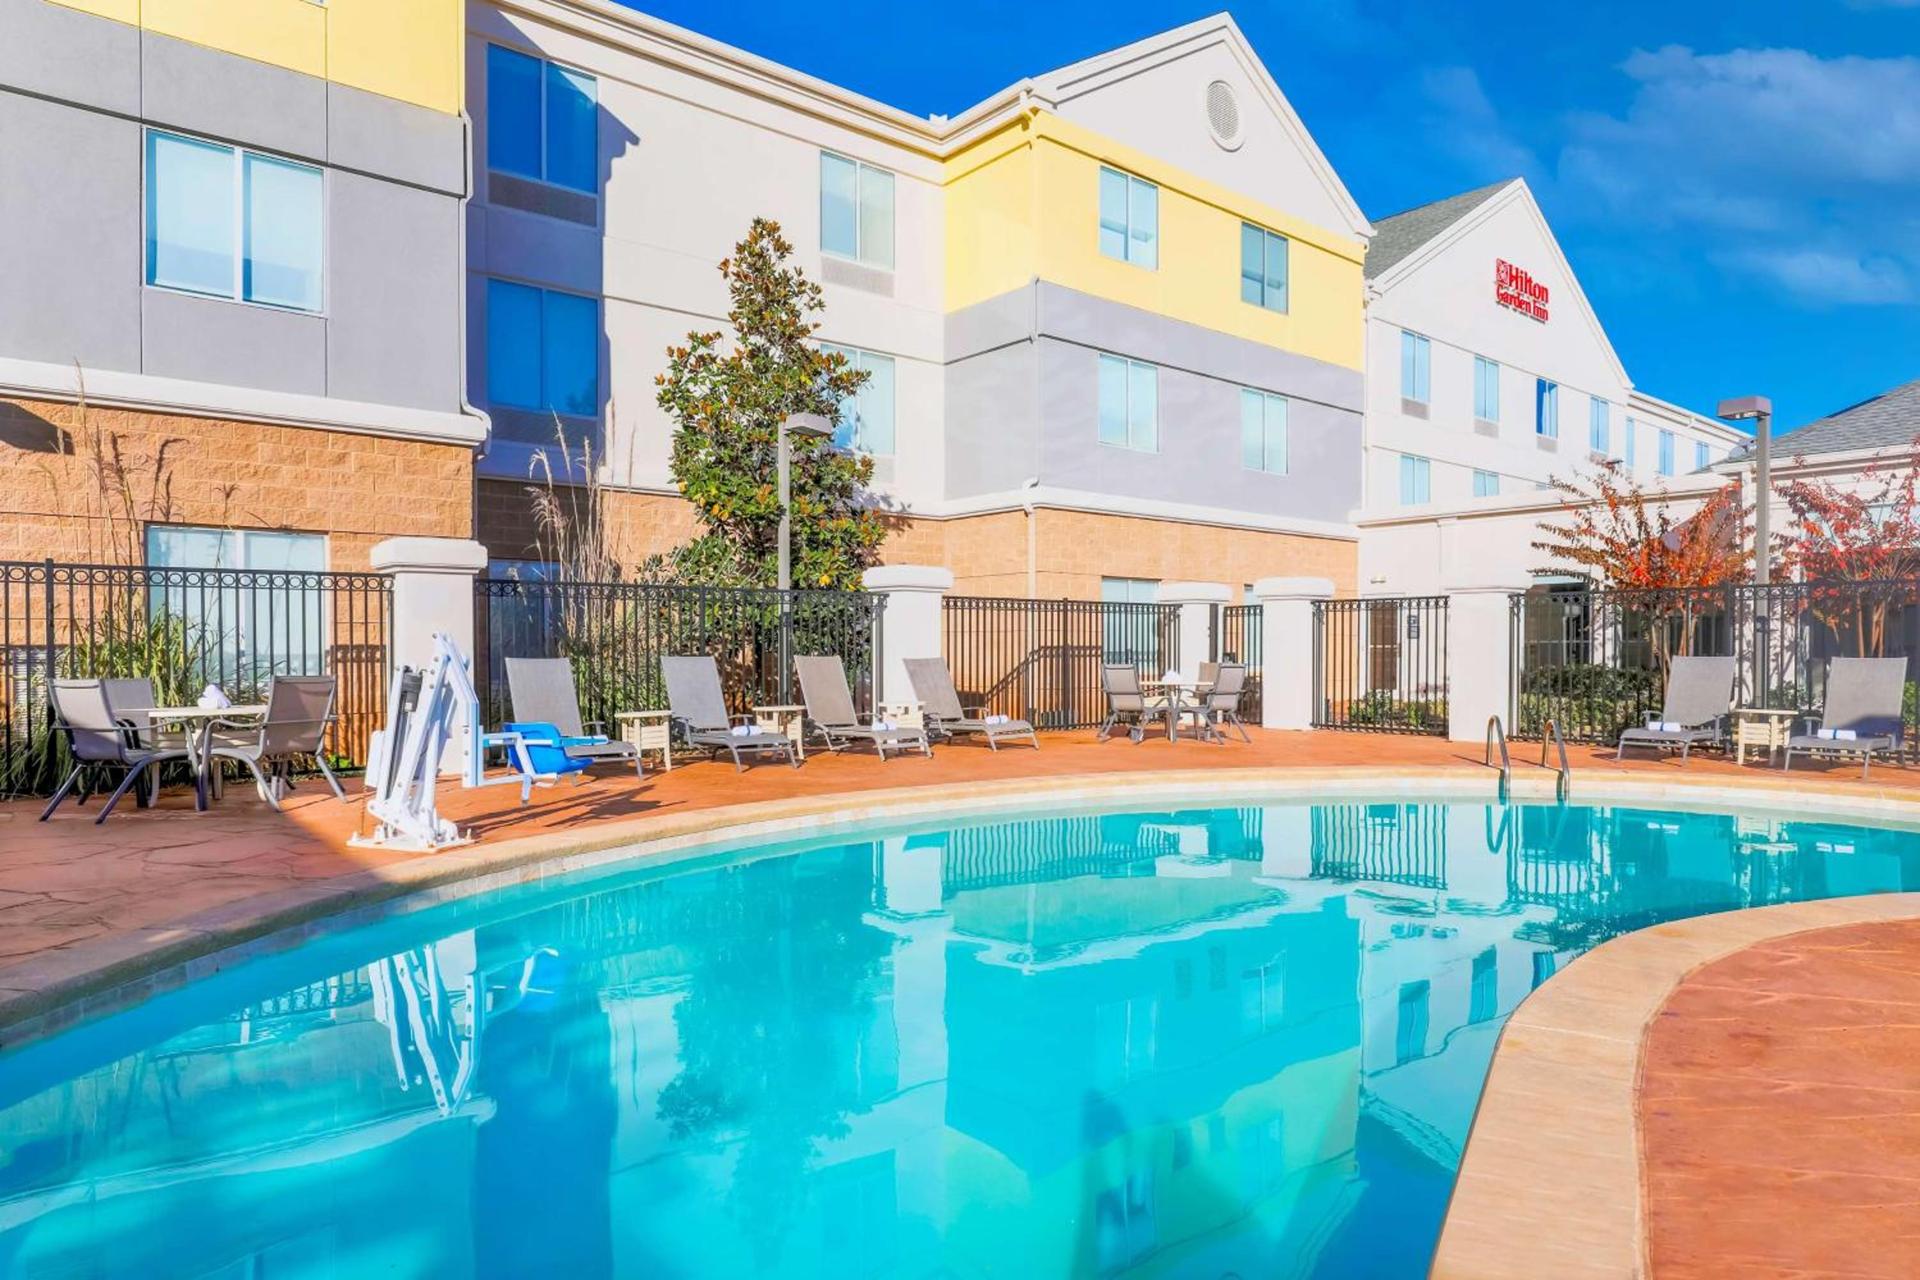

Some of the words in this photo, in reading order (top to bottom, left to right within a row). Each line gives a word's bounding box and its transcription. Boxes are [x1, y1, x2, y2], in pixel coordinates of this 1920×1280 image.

[1497, 283, 1531, 313] Garden
[1533, 299, 1548, 321] Inn
[1508, 264, 1548, 303] Hilton
